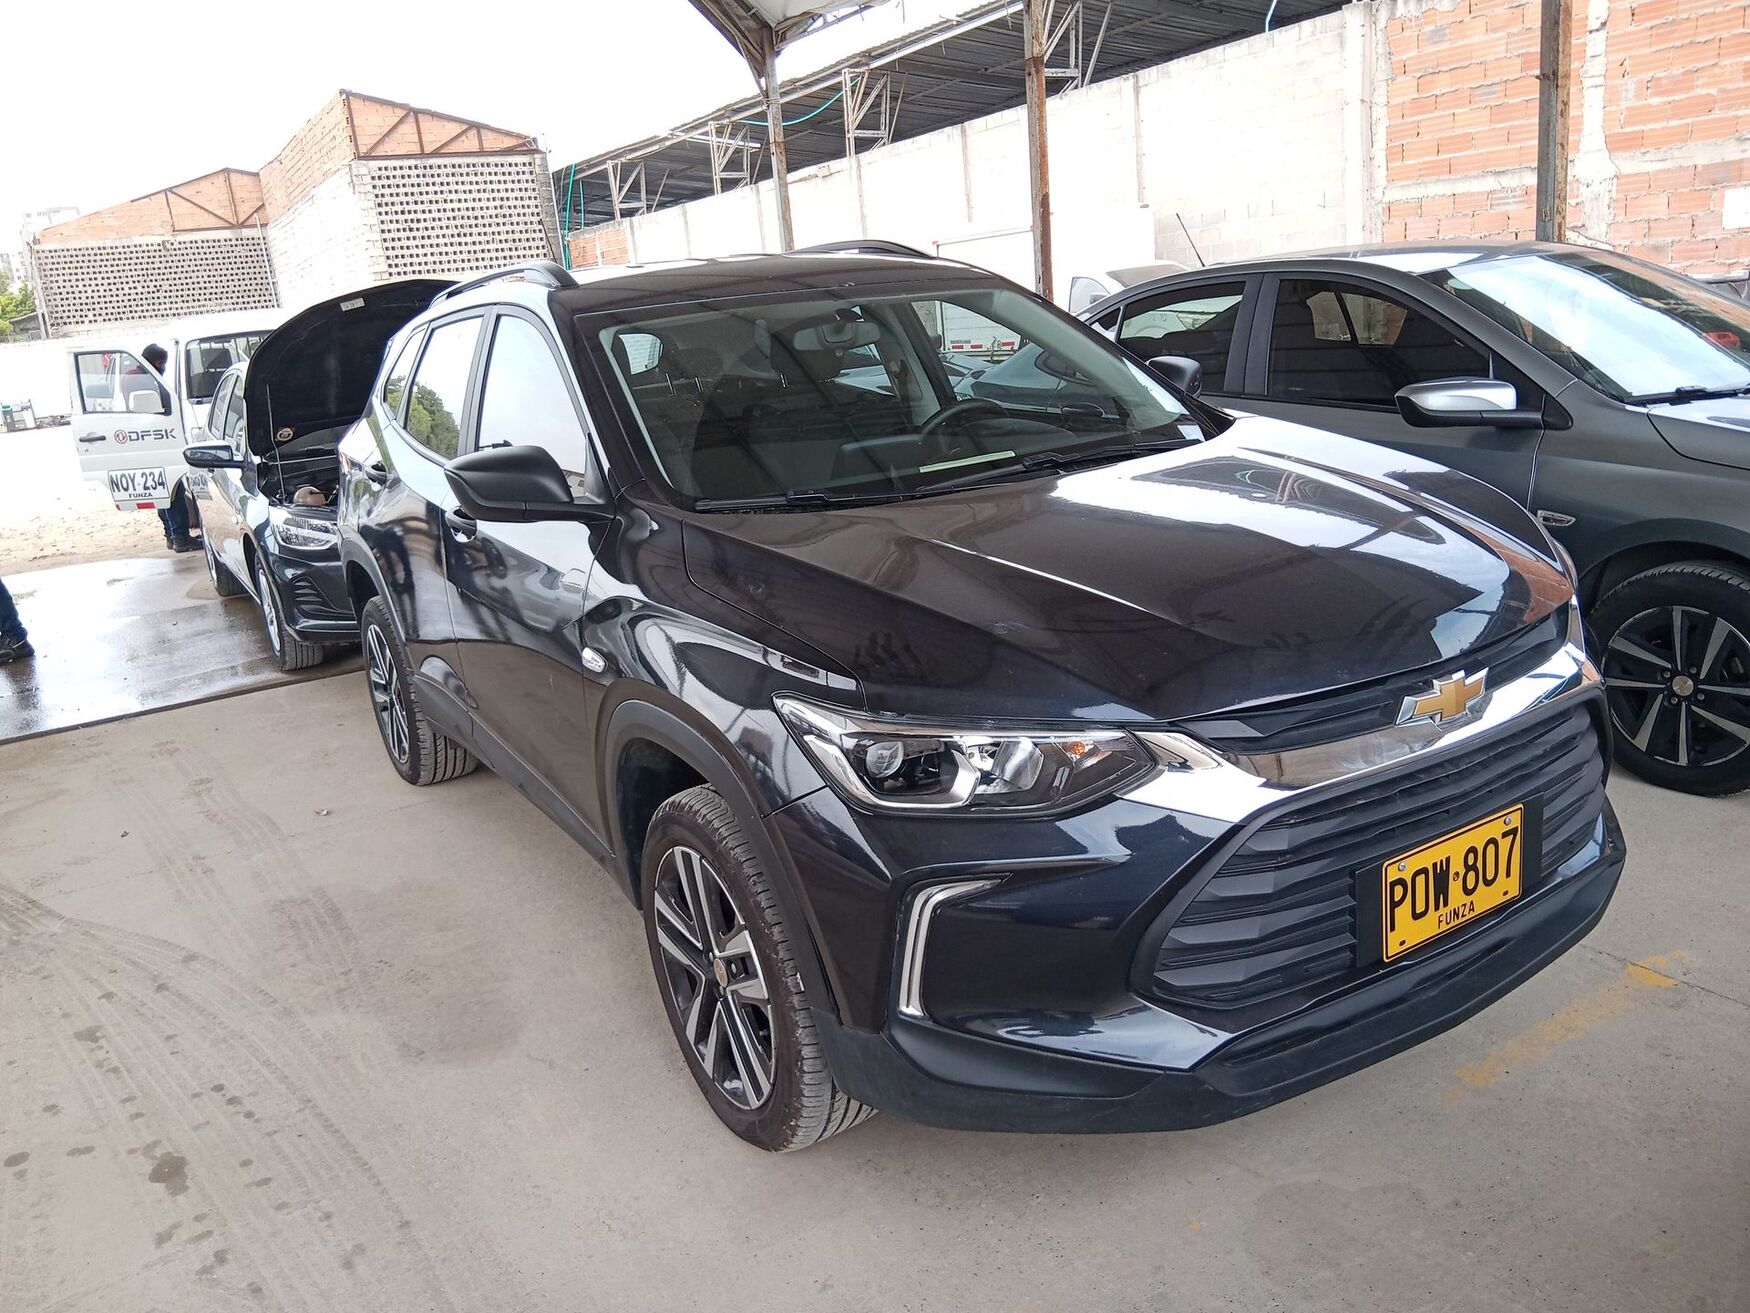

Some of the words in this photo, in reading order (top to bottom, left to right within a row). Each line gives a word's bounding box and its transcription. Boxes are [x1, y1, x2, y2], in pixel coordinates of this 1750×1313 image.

[128, 428, 177, 442] DFSK
[109, 472, 137, 492] NOY
[141, 471, 166, 490] 234
[1389, 855, 1450, 933] POW
[1462, 826, 1519, 896] 807
[1437, 901, 1475, 929] FUNZA
